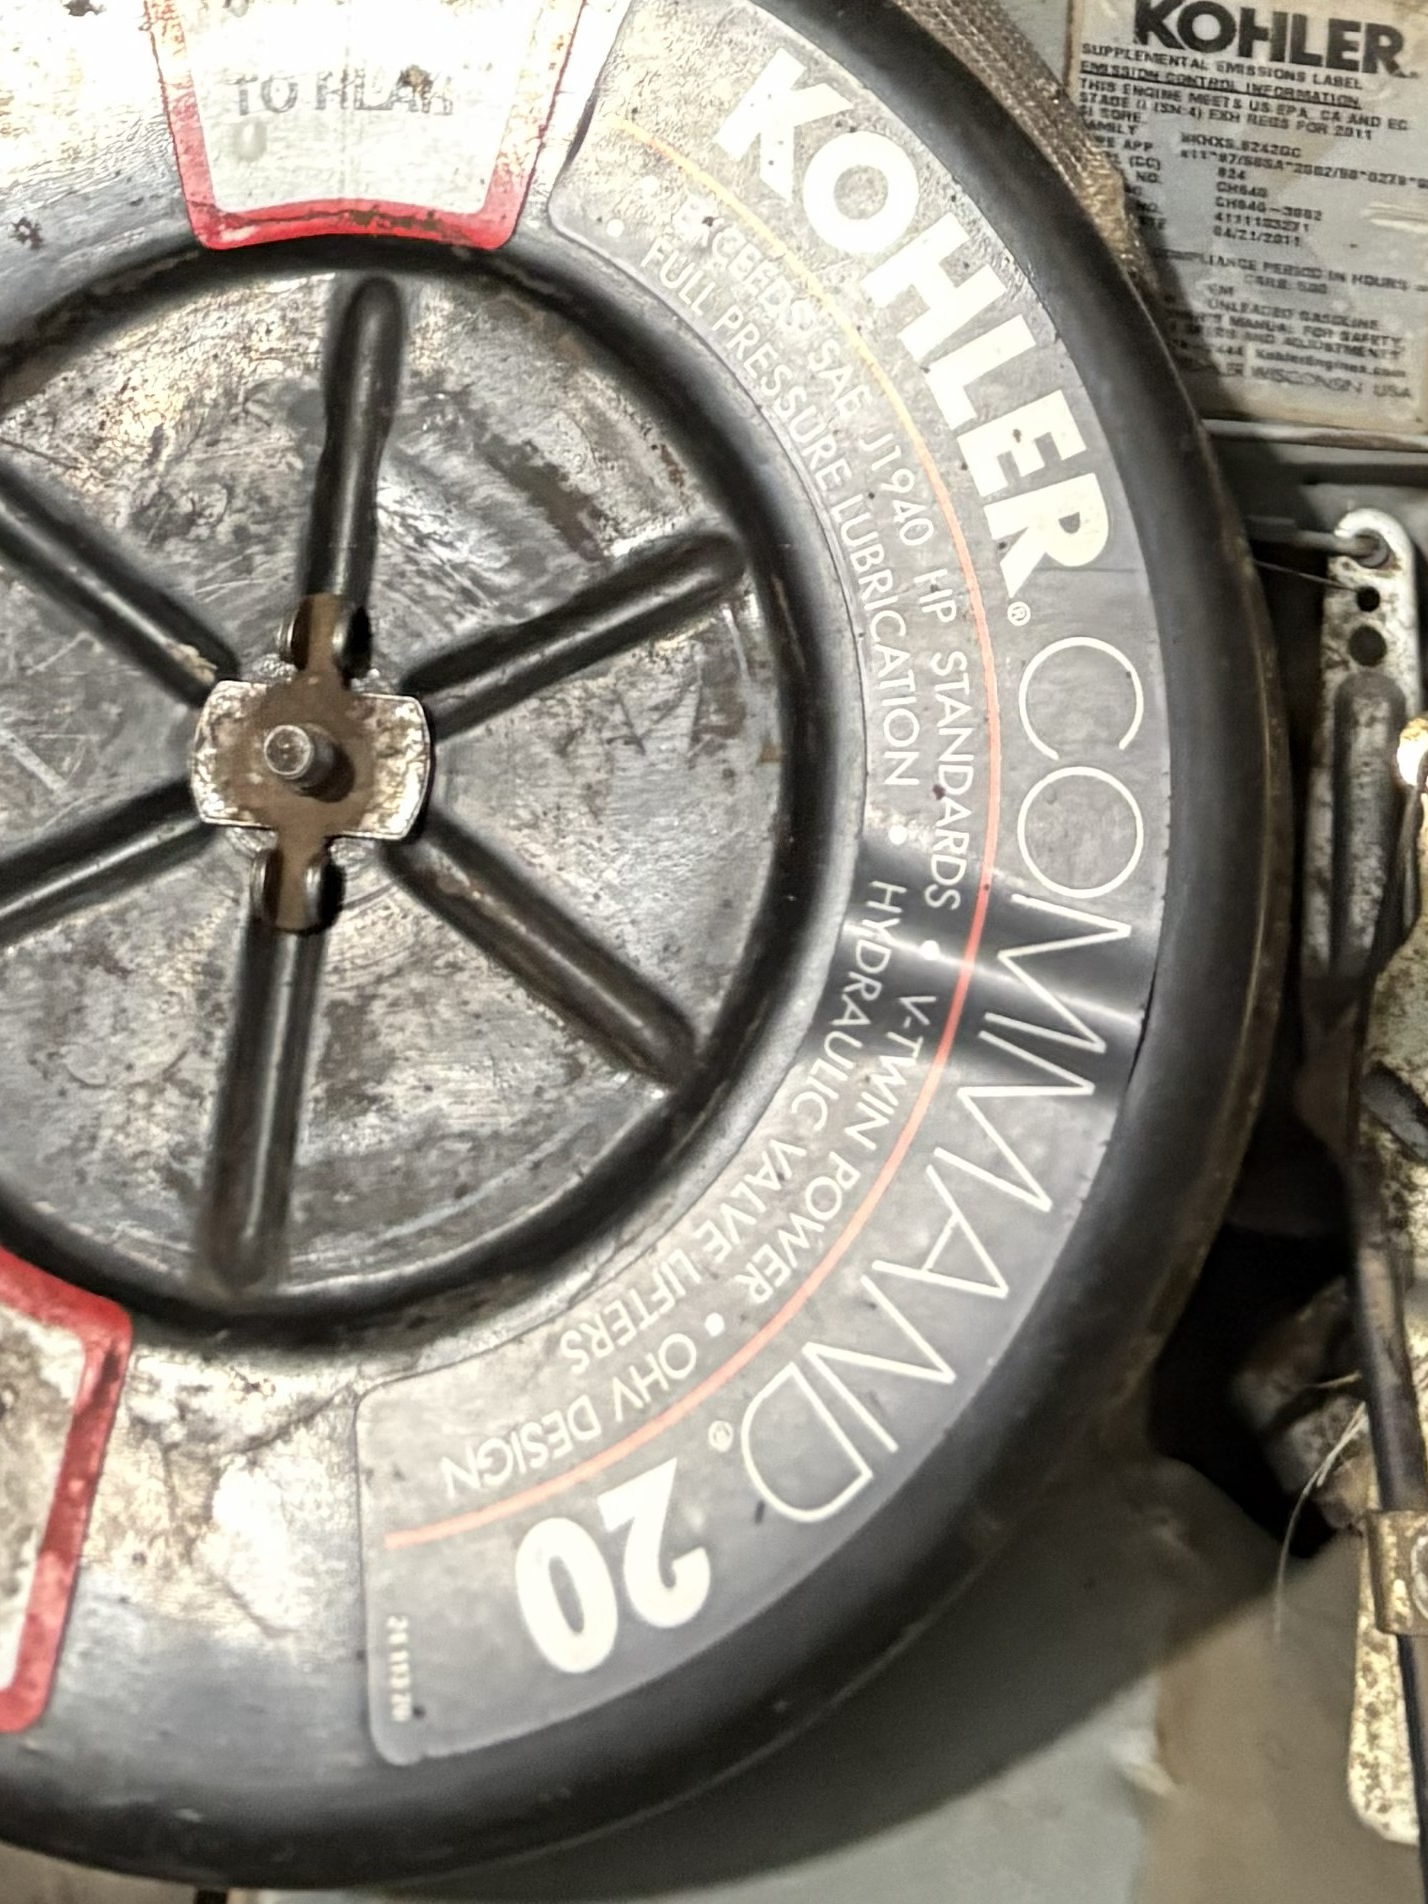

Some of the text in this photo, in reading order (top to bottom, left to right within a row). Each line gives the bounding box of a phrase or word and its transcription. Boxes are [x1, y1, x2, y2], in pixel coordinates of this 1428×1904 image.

[1080, 60, 1163, 81] EMISSION
[1165, 71, 1239, 91] CONTROL
[1081, 42, 1364, 90] SUPPLEMENTAL EMISSIONS LABEL
[230, 73, 298, 116] TO
[1079, 77, 1117, 93] THIS
[1122, 83, 1182, 102] ENGINE
[1188, 92, 1243, 109] MEETS
[1249, 98, 1271, 113] US
[1322, 108, 1341, 122] CA
[1348, 111, 1382, 127] AND
[1388, 118, 1409, 130] EC
[1079, 93, 1130, 109] STAGE
[1209, 108, 1241, 123] EXH
[1247, 113, 1290, 129] REGS
[1296, 119, 1329, 134] FOR
[1334, 123, 1374, 140] 2011
[1123, 140, 1154, 153] APP
[1129, 155, 1161, 171] (CC)
[1218, 167, 1247, 181] 824
[1212, 226, 1302, 247] 04/21/2011
[1263, 261, 1323, 281] PERIOD
[1328, 270, 1346, 282] IN
[1351, 272, 1409, 293] HOURS
[1207, 299, 1294, 319] UNLEADED
[1299, 309, 1379, 330] GASOLINE
[1243, 330, 1276, 343] AND
[1303, 324, 1337, 338] FOR
[1252, 366, 1363, 394] WISCONSIN
[1372, 383, 1412, 398] USA
[559, 238, 922, 1376] FULL PRESSURE LUBRICATION HYDRAULIC VALVE LIFTERS
[439, 192, 976, 1499] EXCEEDS SAE J1940 HP STANDARDS V-TWIN POWER OHV DESIGN
[514, 45, 1145, 1675] KOHLER COMMAND 20
